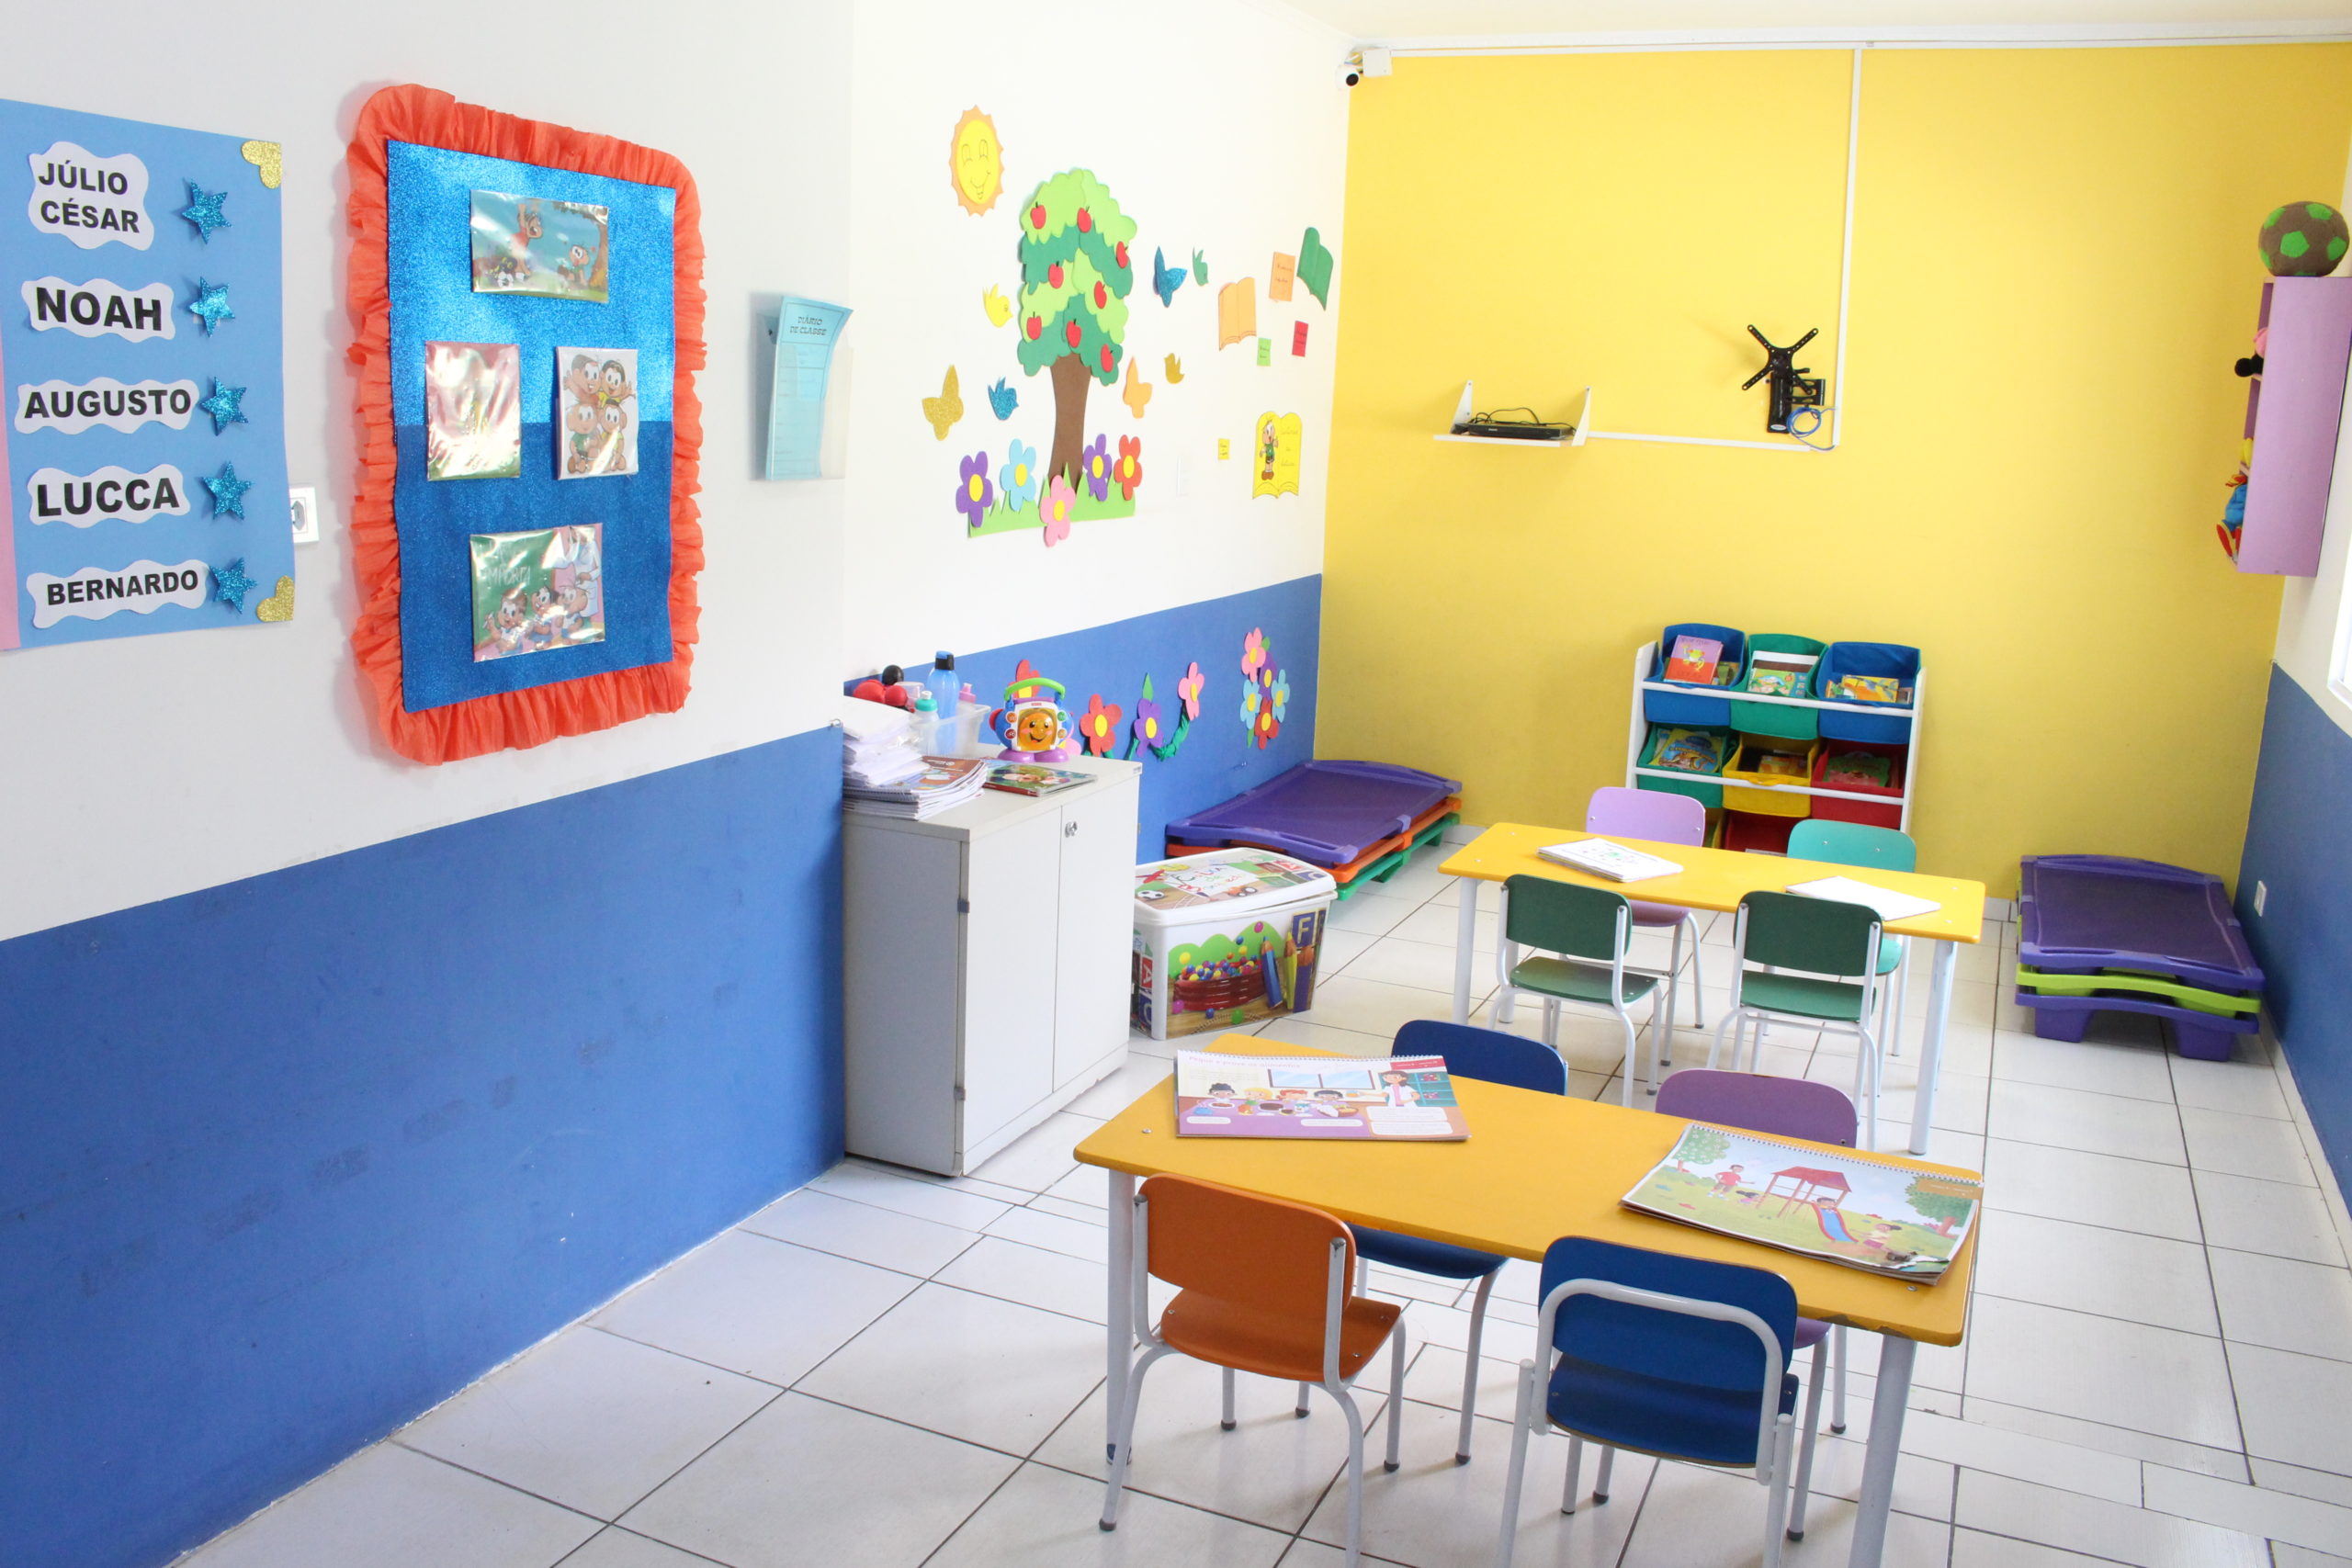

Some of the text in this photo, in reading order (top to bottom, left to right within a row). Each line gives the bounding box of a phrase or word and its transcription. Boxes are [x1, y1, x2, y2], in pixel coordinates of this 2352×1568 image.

[39, 159, 128, 195] JÚLIO
[40, 198, 139, 233] CÉSAR
[36, 287, 162, 332] NOAH
[24, 389, 191, 419] AUGUSTO
[37, 478, 179, 517] LUCCA
[47, 569, 198, 605] BERNARDO
[1297, 917, 1311, 943] F
